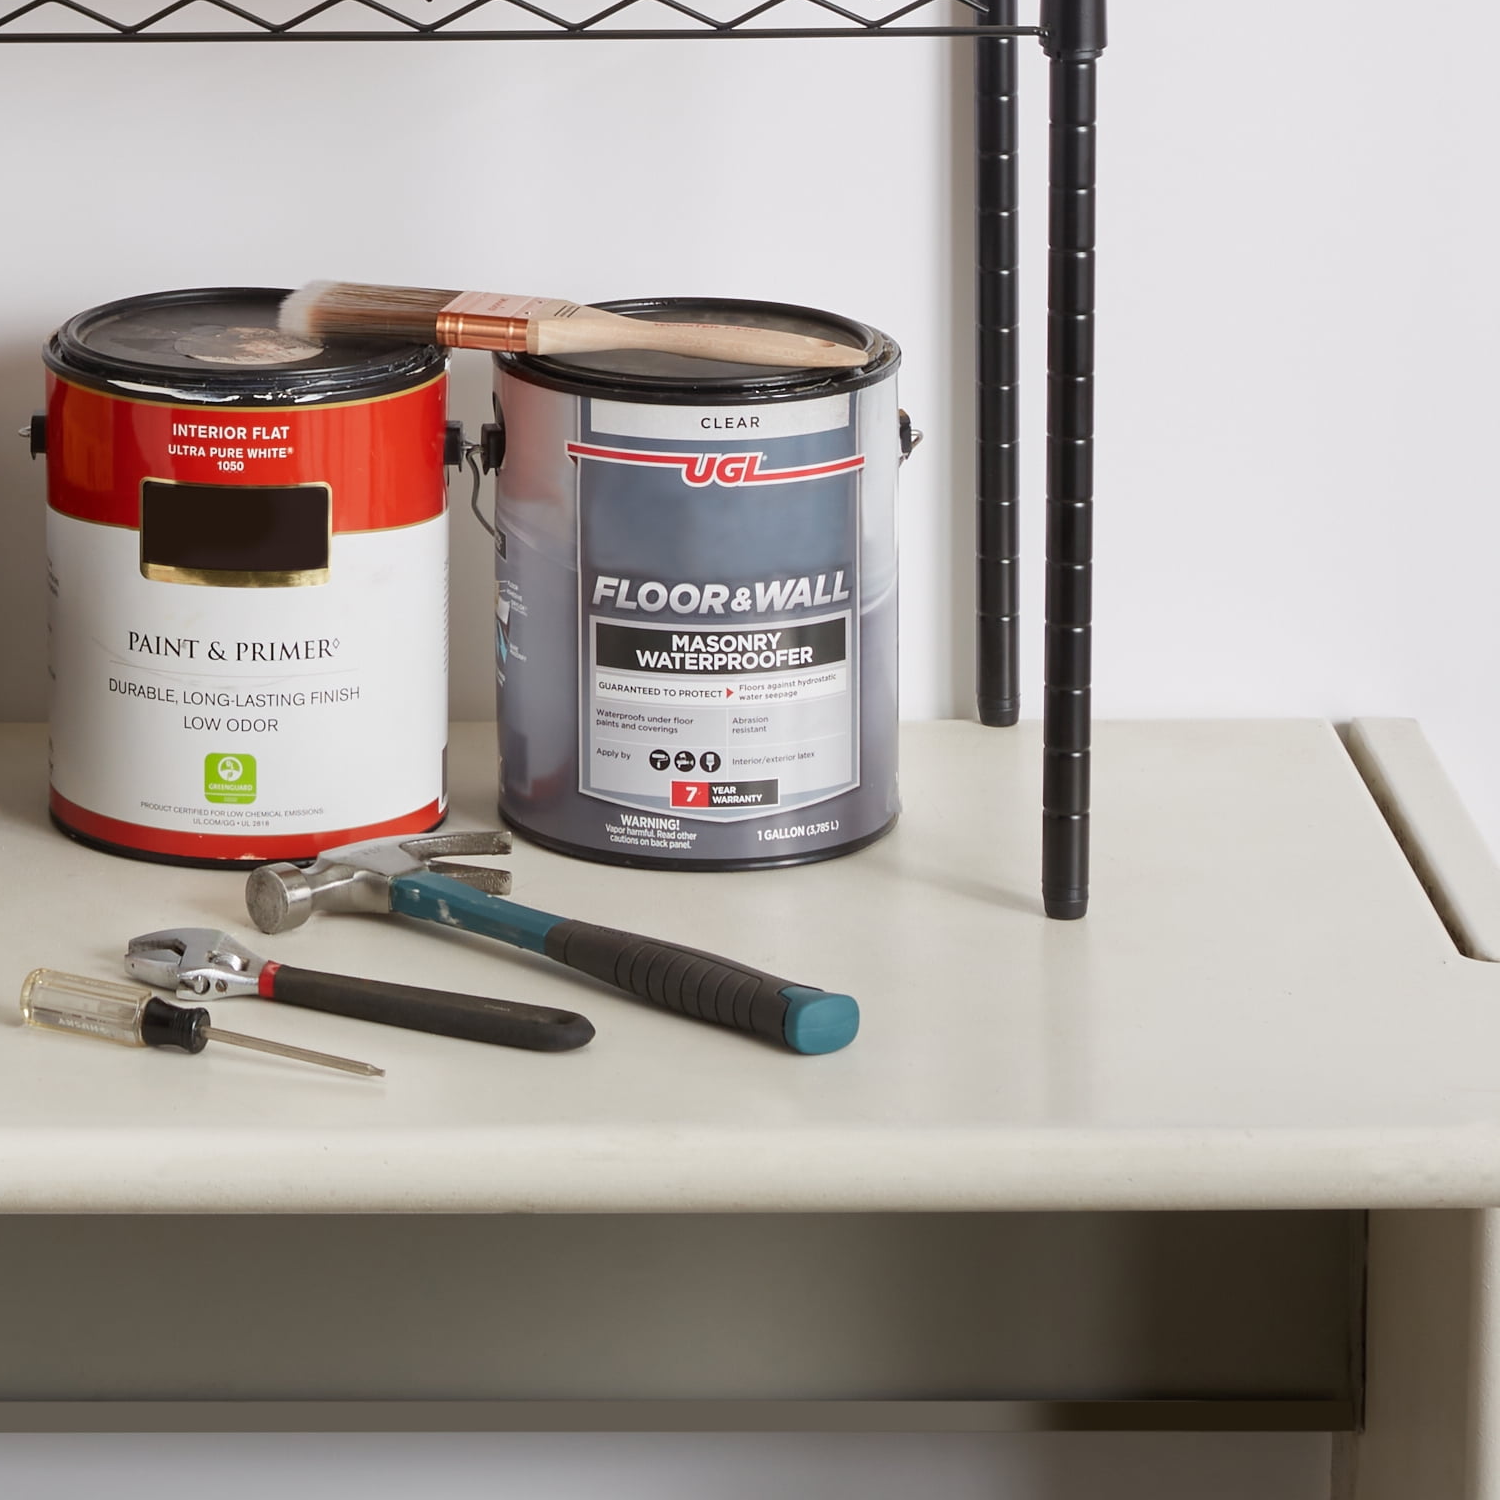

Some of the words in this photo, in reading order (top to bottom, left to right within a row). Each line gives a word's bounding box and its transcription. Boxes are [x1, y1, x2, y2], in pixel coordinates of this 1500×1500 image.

[701, 416, 760, 429] CLEAR
[172, 423, 247, 440] INTERIOR
[252, 426, 290, 440] FLAT
[168, 443, 206, 457] ULTRA
[209, 447, 243, 458] PURE
[217, 461, 244, 471] 1050
[682, 453, 763, 487] UGL
[128, 631, 199, 659] PAINT
[207, 641, 228, 661] &
[671, 632, 782, 653] MASONRY
[635, 646, 813, 670] WATERPROOFER
[598, 681, 660, 697] GUARANTEED
[663, 689, 677, 698] TO
[679, 689, 722, 698] PROTECT
[739, 683, 765, 692] Floors
[767, 680, 796, 693] against
[797, 673, 836, 688] hydrostatic
[109, 678, 178, 705] DURABLE,
[183, 691, 305, 708] LONG-LASTING
[311, 687, 360, 705] FINISH
[739, 693, 763, 701] water
[765, 690, 798, 702] seepage
[184, 716, 221, 731] LOW
[226, 718, 278, 732] ODOR
[596, 709, 645, 723] Waterproofs
[647, 715, 671, 724] under
[673, 715, 694, 725] floor
[732, 715, 768, 725] Abrasion
[596, 718, 619, 730] paints
[621, 721, 636, 731] and
[638, 724, 678, 734] coverings
[732, 725, 766, 734] resistant
[596, 748, 618, 760] Apply
[620, 751, 631, 761] by
[732, 755, 796, 766] Interior/exterior
[797, 751, 815, 760] latex
[685, 787, 698, 802] 7
[712, 786, 736, 795] YEAR
[712, 794, 763, 804] WARRANTY
[140, 801, 172, 813] PRODUCT
[173, 807, 209, 816] CERTIFIED
[210, 809, 226, 817] FOR
[227, 809, 243, 818] LOW
[245, 809, 283, 818] CHEMICAL
[284, 808, 324, 817] EMISSIONS
[620, 813, 680, 831] WARNING!
[605, 823, 626, 836] Vapor
[626, 826, 655, 838] harmful.
[656, 830, 675, 839] Read
[676, 831, 697, 841] other
[757, 830, 763, 841] 1
[764, 825, 805, 841] GALLON
[610, 833, 639, 846] cautions
[640, 838, 650, 846] on
[650, 838, 668, 848] back
[669, 840, 692, 850] panel.
